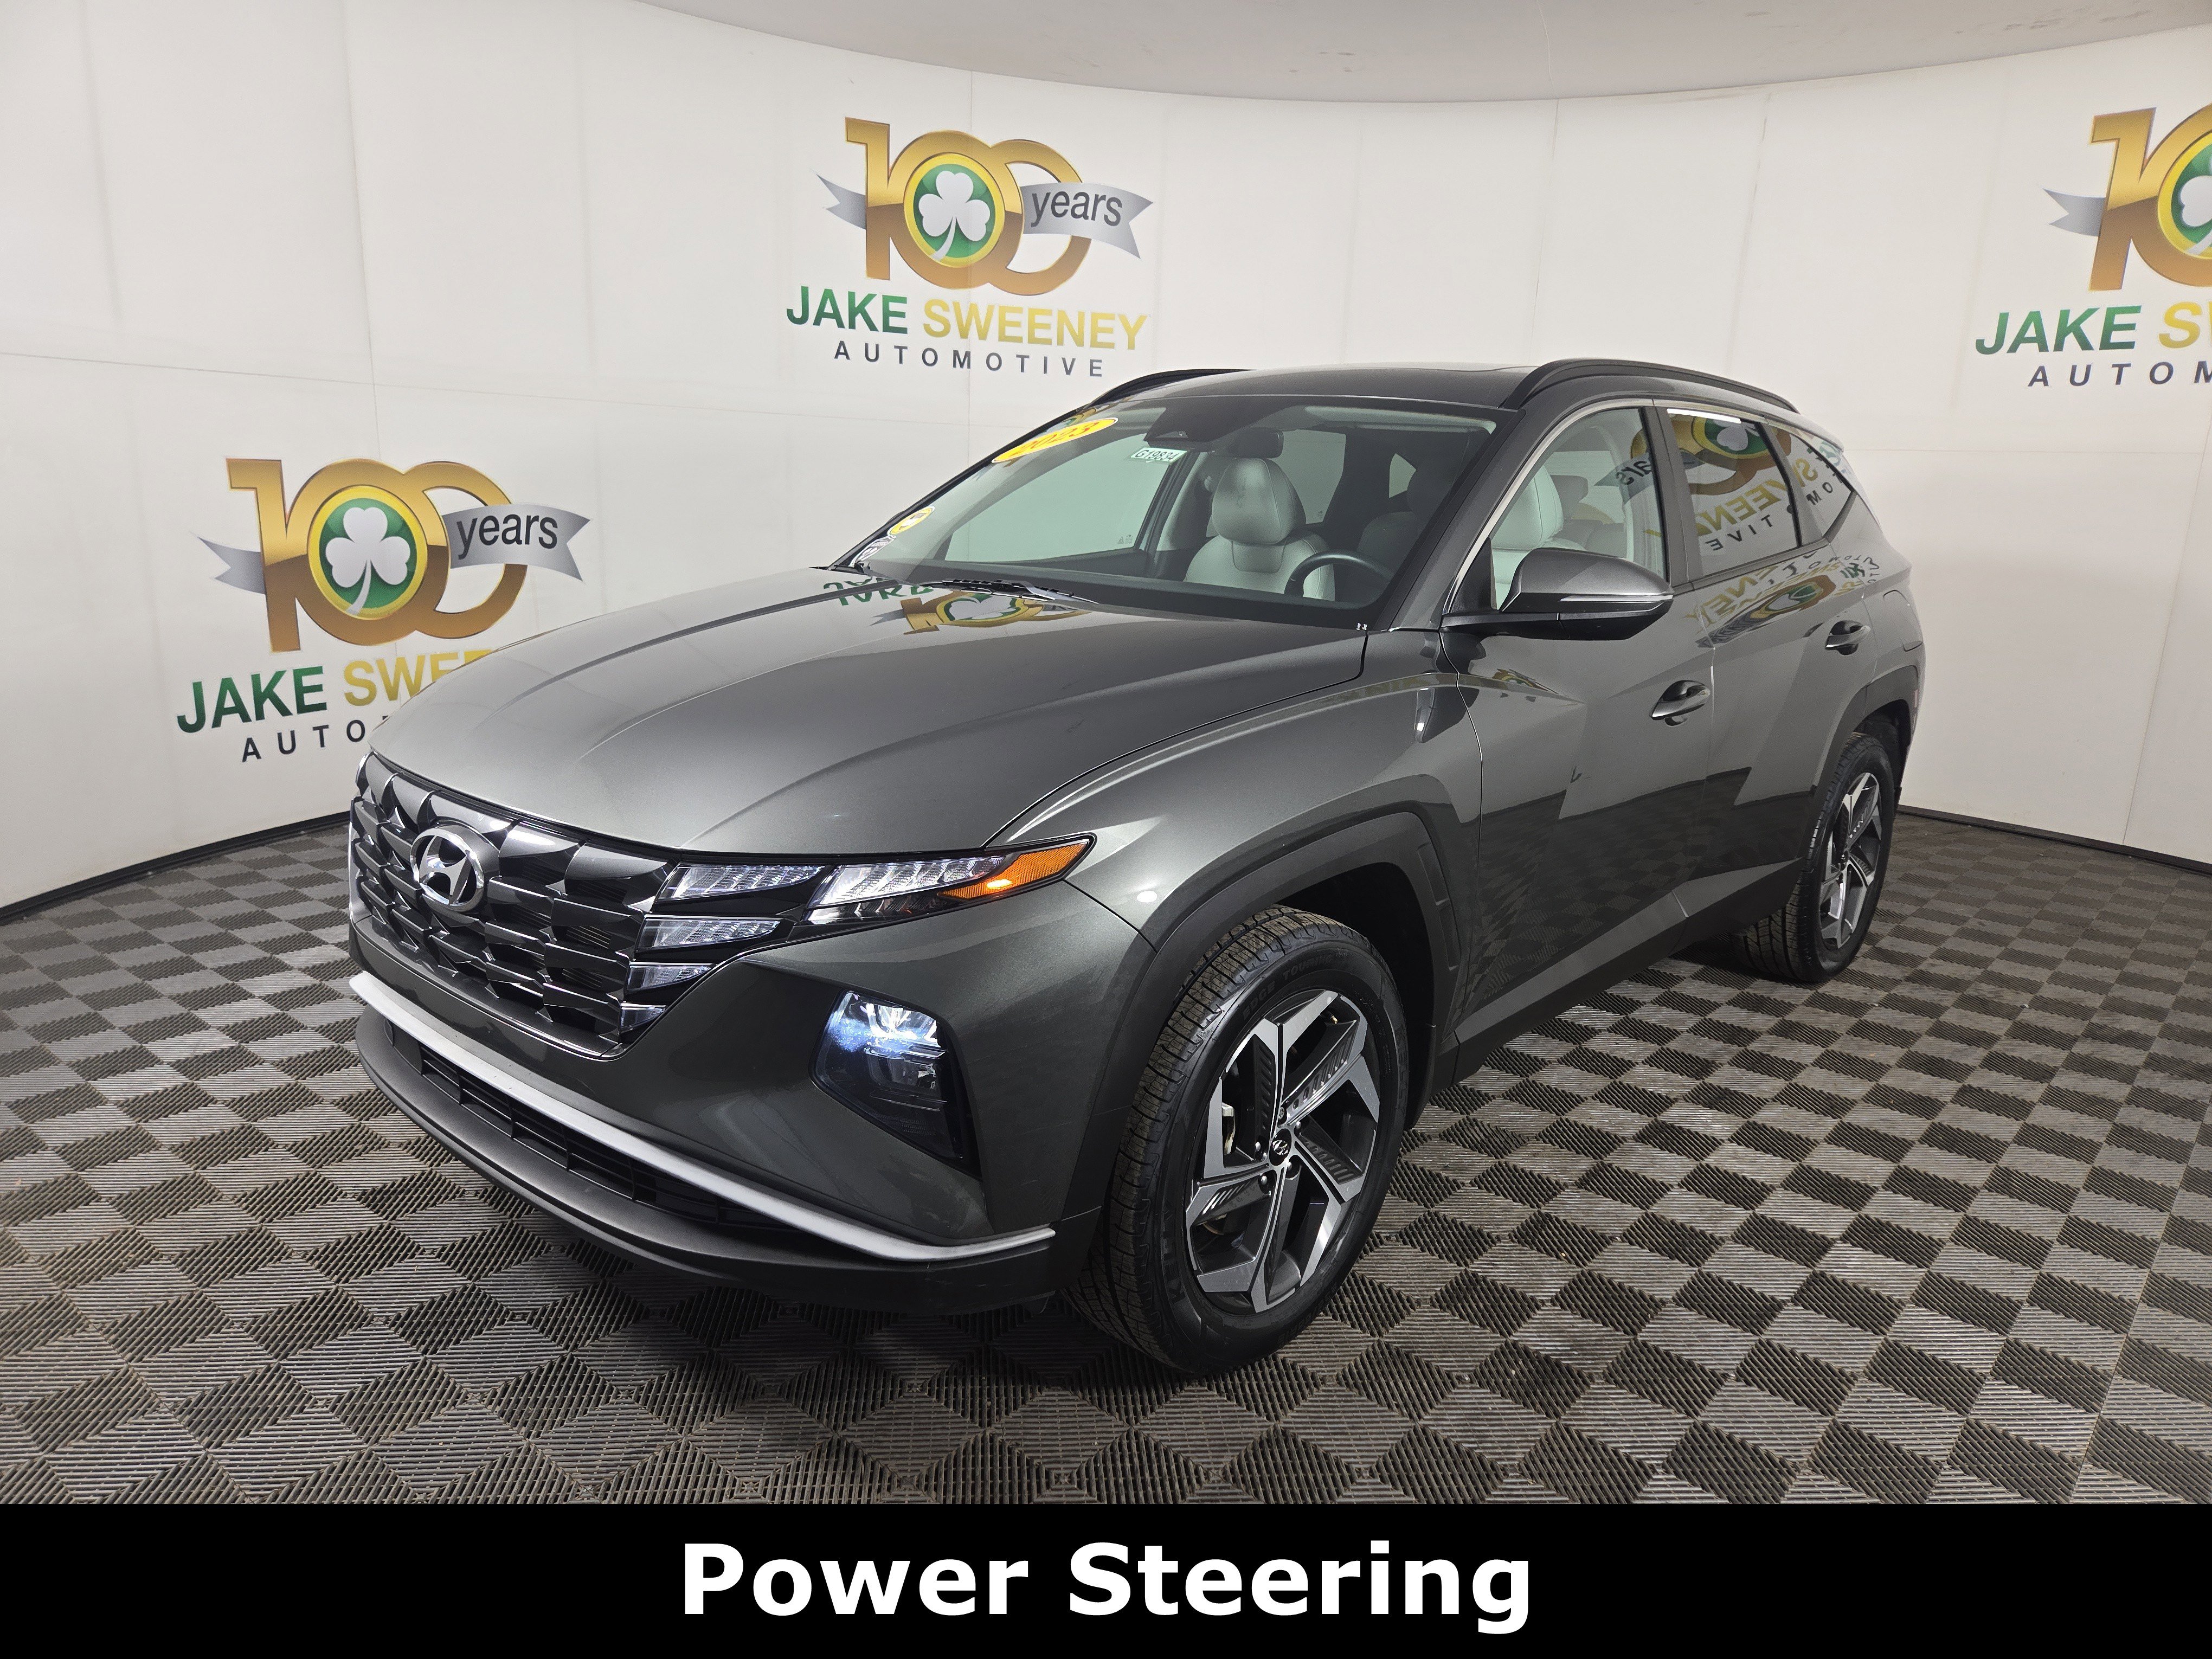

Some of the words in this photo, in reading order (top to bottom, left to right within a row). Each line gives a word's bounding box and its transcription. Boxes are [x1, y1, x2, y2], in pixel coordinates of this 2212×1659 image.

[844, 117, 1092, 297] 100
[1031, 190, 1123, 227] years
[786, 286, 908, 335] JAKE
[923, 298, 1148, 351] SWEENEY
[1975, 305, 2142, 355] JAKE
[2158, 301, 2212, 349] S
[834, 340, 1103, 378] AUTOMOTIVE
[1007, 421, 1101, 458] 2023
[1135, 449, 1180, 462] G19834
[226, 458, 529, 653] 100
[456, 513, 559, 560] years
[176, 665, 327, 734] JAKE
[241, 715, 389, 762] AUTO
[1242, 980, 1276, 1021] EDGE
[1282, 954, 1334, 981] TOURING
[1163, 1198, 1186, 1304] KELLY
